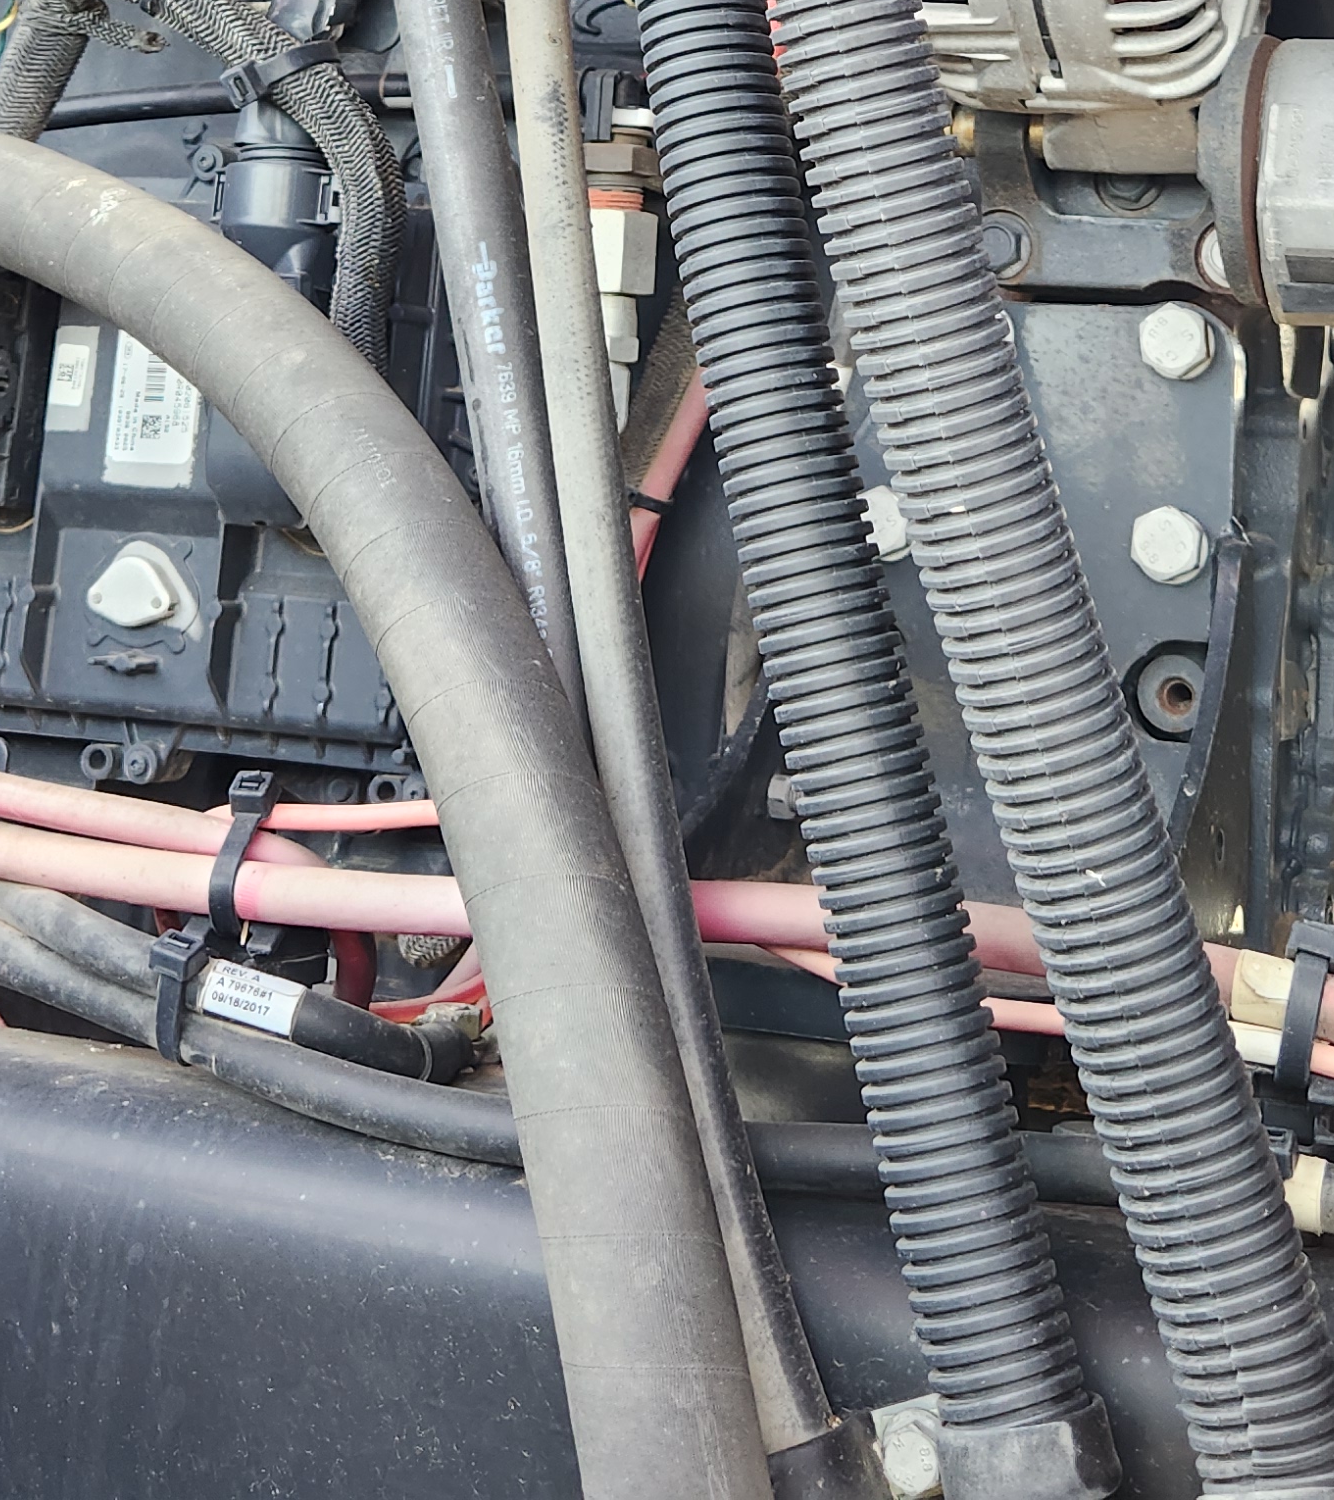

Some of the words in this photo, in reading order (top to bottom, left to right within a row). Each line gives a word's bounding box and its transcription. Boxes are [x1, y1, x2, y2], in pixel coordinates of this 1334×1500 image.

[472, 241, 506, 354] Parker
[496, 361, 517, 403] 7639
[503, 409, 522, 436] MP
[507, 442, 526, 495] 16mm
[216, 977, 225, 988] A
[222, 966, 249, 981] REV.
[249, 974, 261, 983] A
[211, 991, 271, 1016] 09/18/2017
